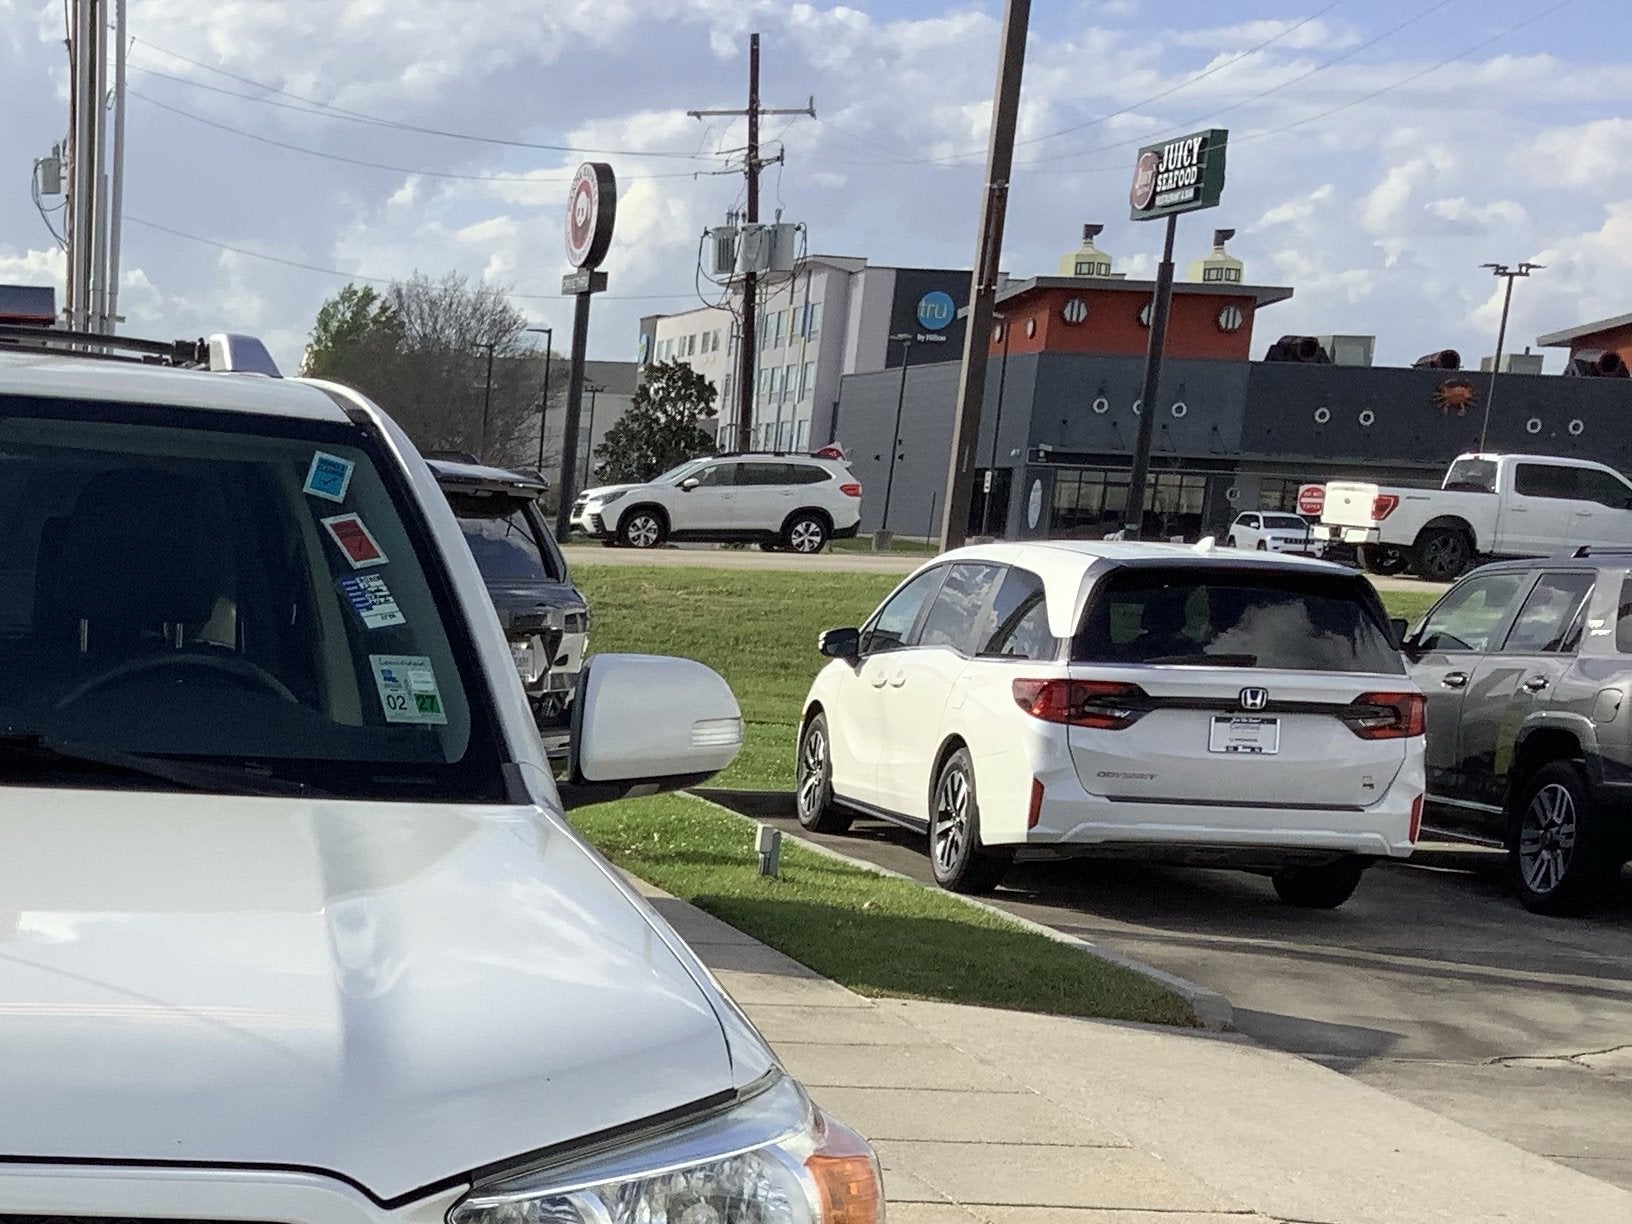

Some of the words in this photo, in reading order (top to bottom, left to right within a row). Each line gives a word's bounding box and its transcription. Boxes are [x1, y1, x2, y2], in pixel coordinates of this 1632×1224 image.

[1159, 137, 1202, 172] JUICY
[1156, 166, 1197, 192] SEAFOOD
[919, 300, 947, 319] tru
[386, 694, 408, 711] 02
[416, 694, 436, 712] 27
